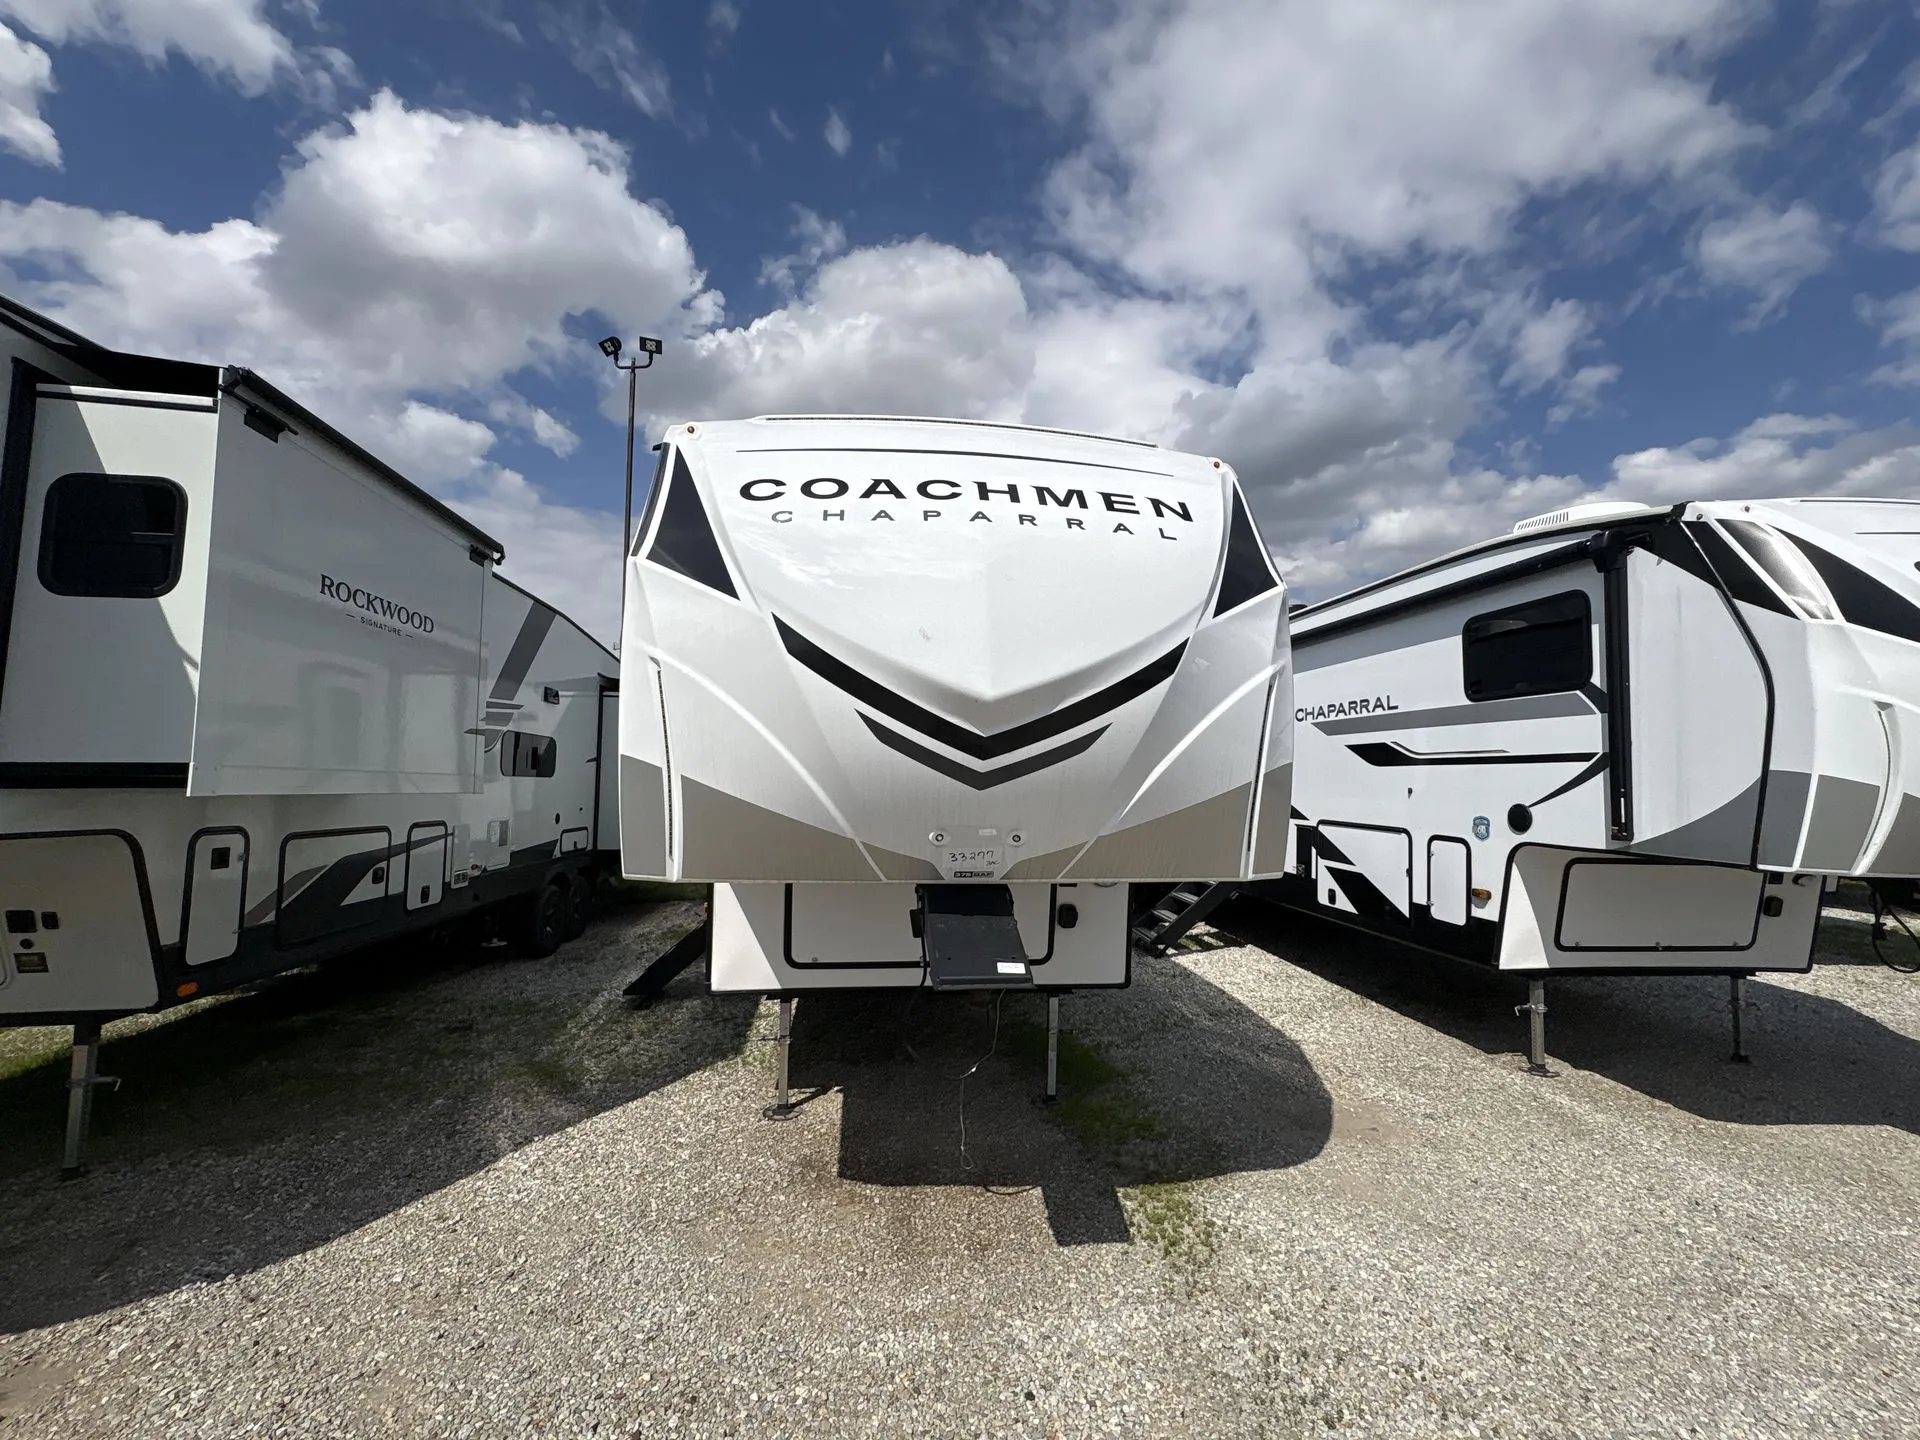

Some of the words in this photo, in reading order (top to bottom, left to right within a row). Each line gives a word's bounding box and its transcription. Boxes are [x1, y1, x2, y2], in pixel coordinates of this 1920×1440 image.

[739, 478, 1194, 523] COACHMEN
[771, 509, 1178, 541] CHAPARRAL
[320, 574, 435, 634] ROCKWOOD
[360, 617, 403, 637] SIGNATURE
[1295, 695, 1399, 722] CHAPARRAL
